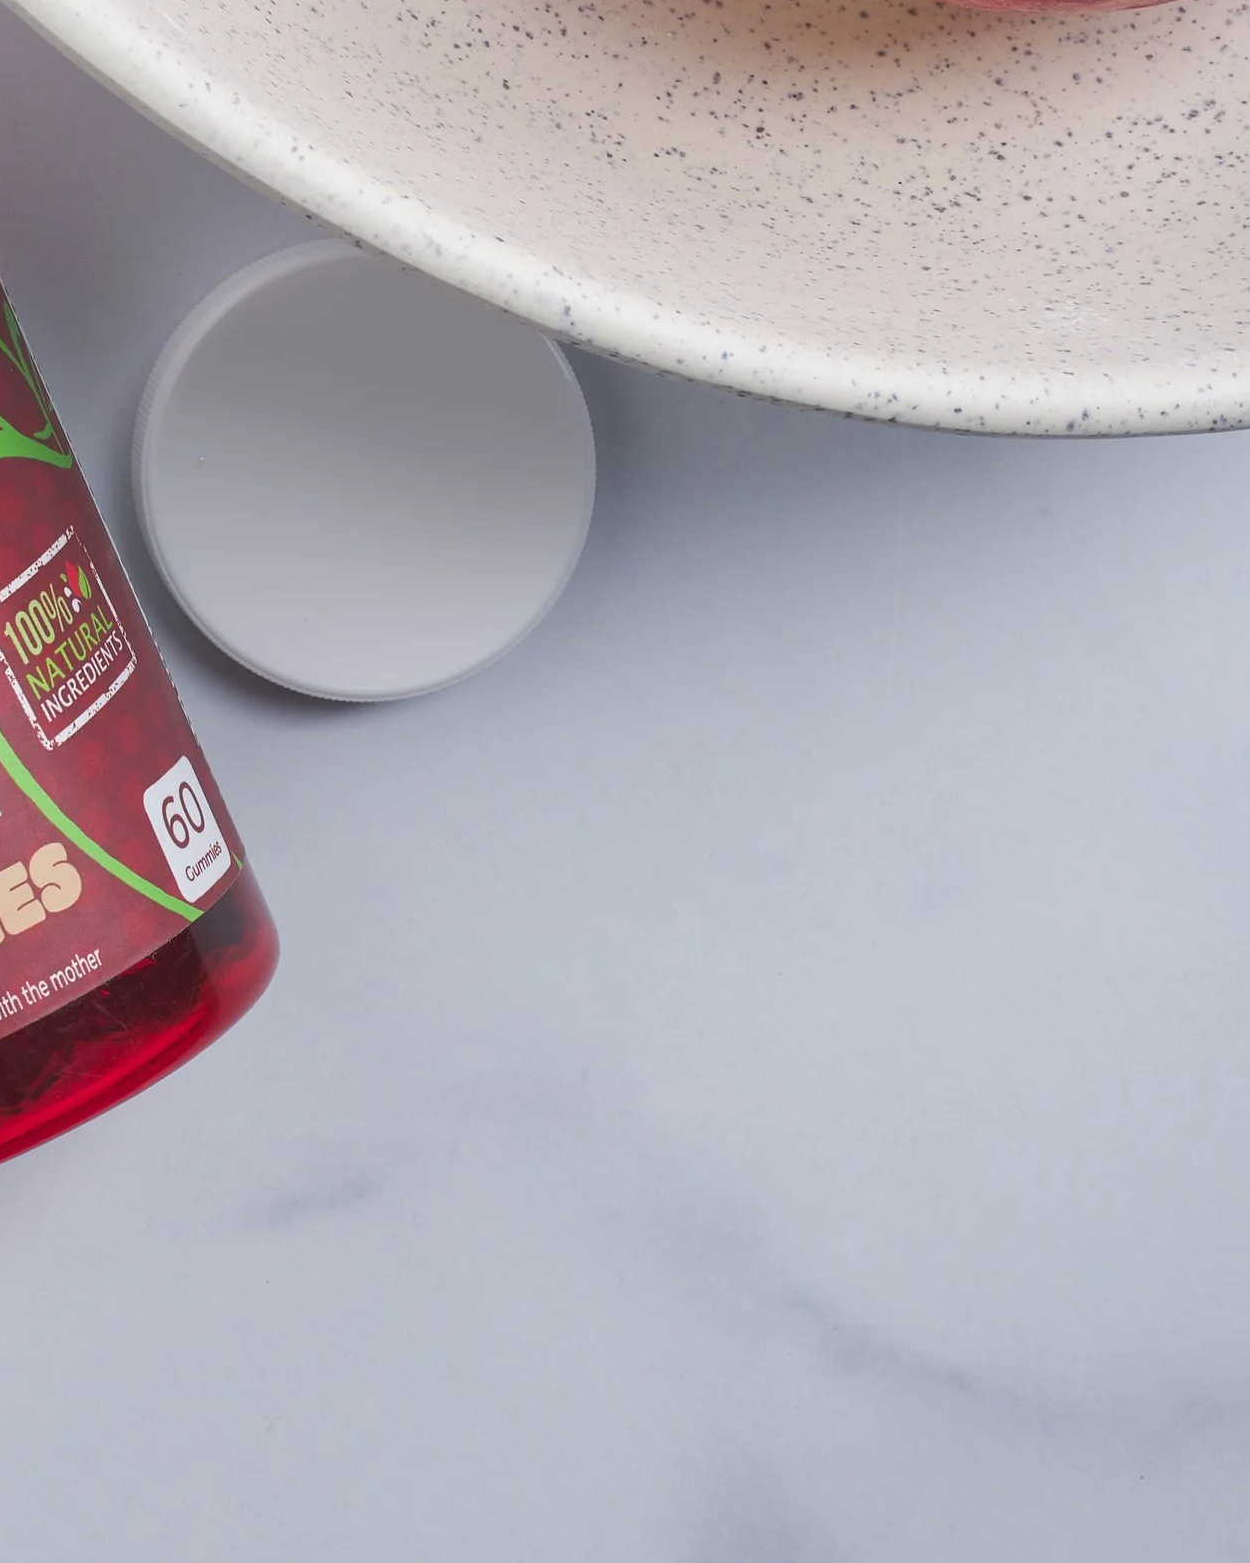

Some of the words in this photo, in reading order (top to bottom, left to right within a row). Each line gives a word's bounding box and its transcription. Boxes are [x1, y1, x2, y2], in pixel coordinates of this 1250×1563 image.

[3, 583, 75, 665] 100%
[25, 605, 114, 701] NATURAL
[40, 629, 124, 723] INGREDIENTS
[161, 780, 206, 850] 60
[184, 840, 223, 882] Gummies
[21, 976, 51, 1001] the
[48, 948, 104, 992] mother
